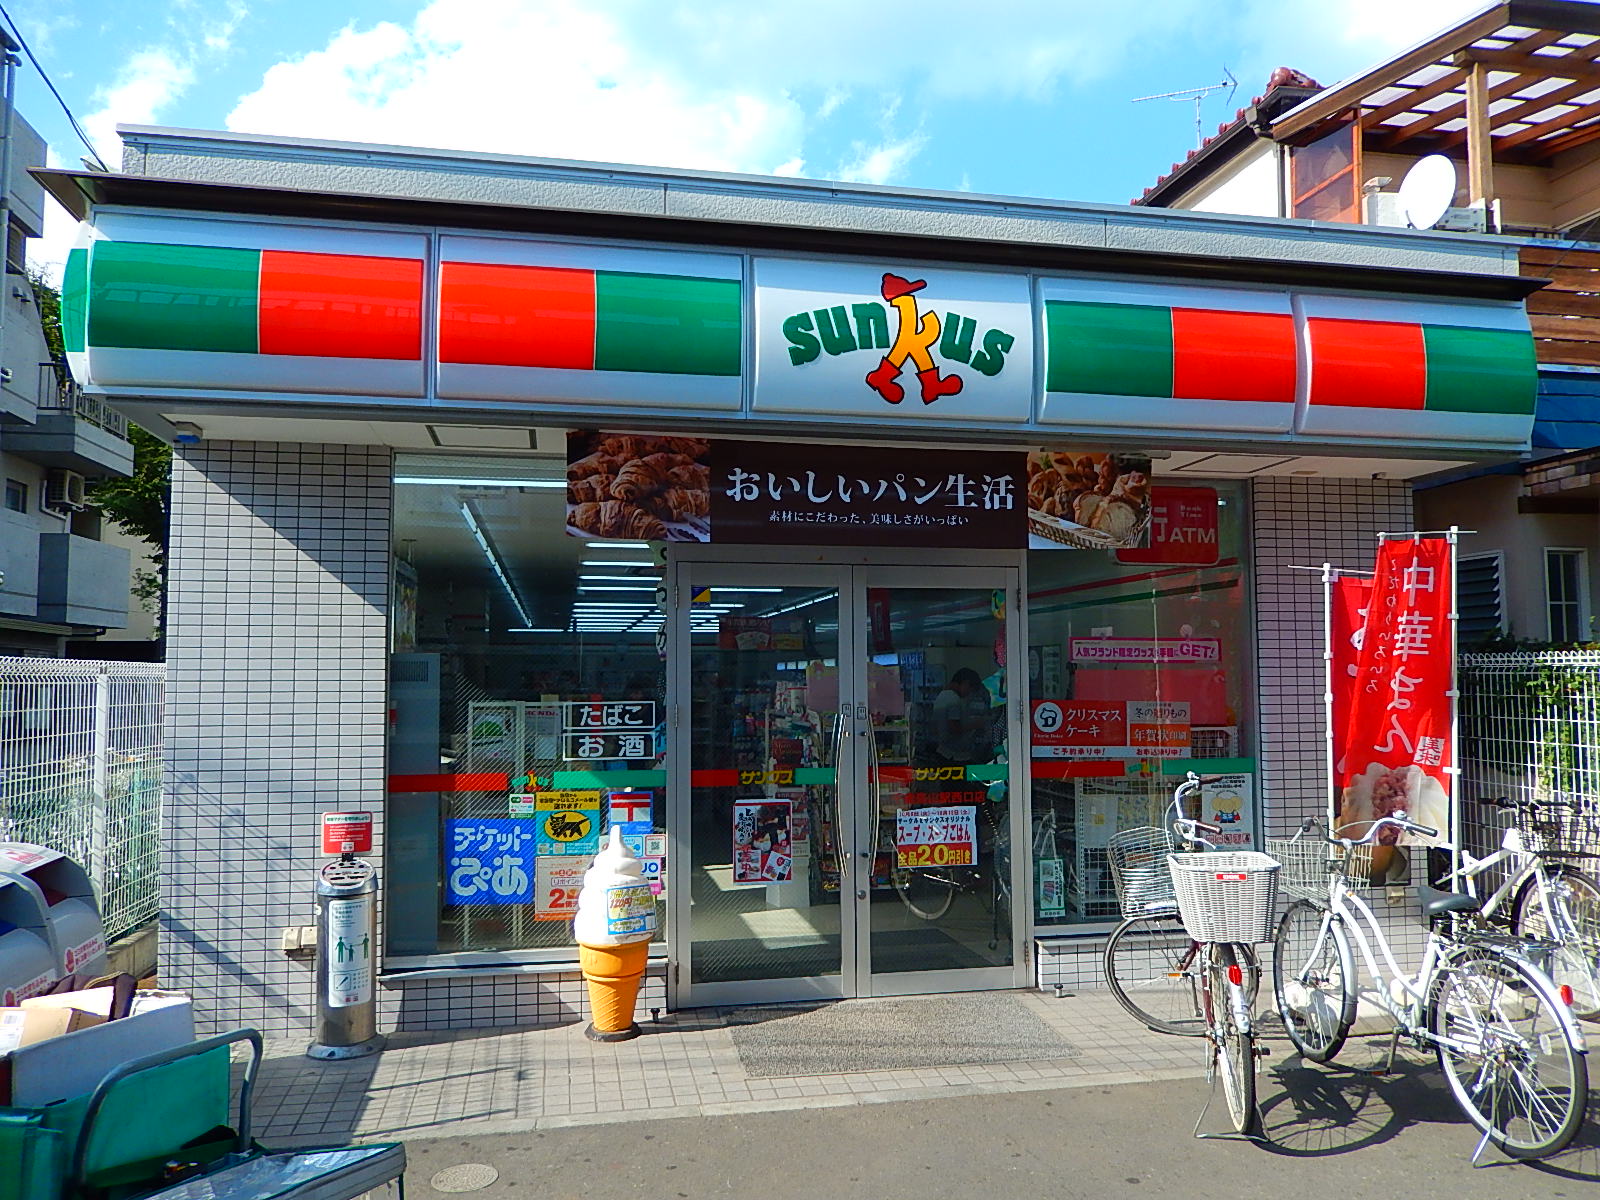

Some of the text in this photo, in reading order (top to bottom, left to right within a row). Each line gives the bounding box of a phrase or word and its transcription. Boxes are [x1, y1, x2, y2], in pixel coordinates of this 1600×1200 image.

[726, 467, 1015, 510] おいしいパン生活
[769, 510, 969, 525] 素材にこだわった、美味しさがいっぱい
[580, 705, 643, 726] たばこ
[1066, 709, 1121, 721] クリスマス
[1066, 725, 1101, 738] ケーキ
[741, 770, 793, 785] サンクス
[915, 766, 965, 781] サンクス
[454, 825, 532, 851] チケット
[450, 855, 529, 896] ぴあ
